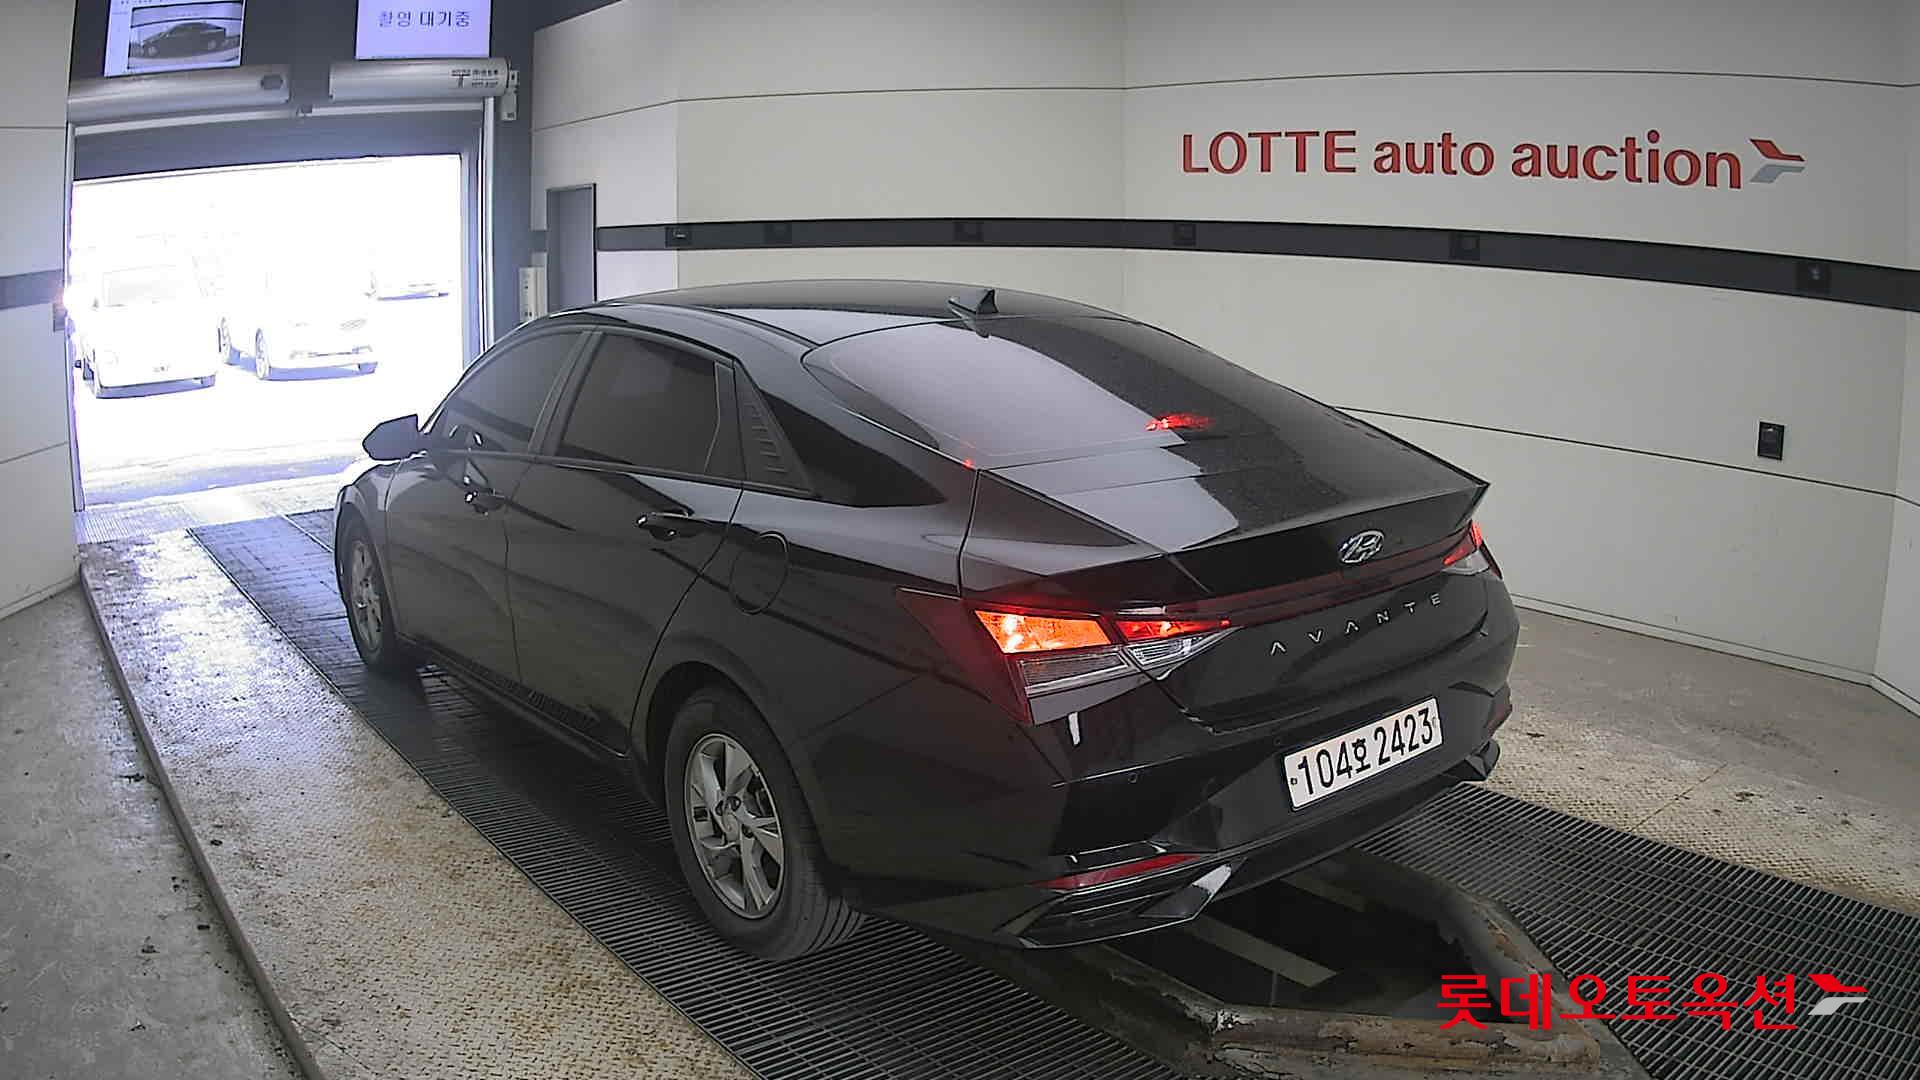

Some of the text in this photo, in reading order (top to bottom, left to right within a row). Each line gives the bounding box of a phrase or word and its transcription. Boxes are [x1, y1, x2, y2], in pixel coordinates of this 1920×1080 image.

[419, 11, 470, 27] 대기중
[1182, 130, 1742, 189] LOTTE auto auction
[1269, 593, 1441, 656] AVANTE
[1374, 707, 1433, 766] 2423
